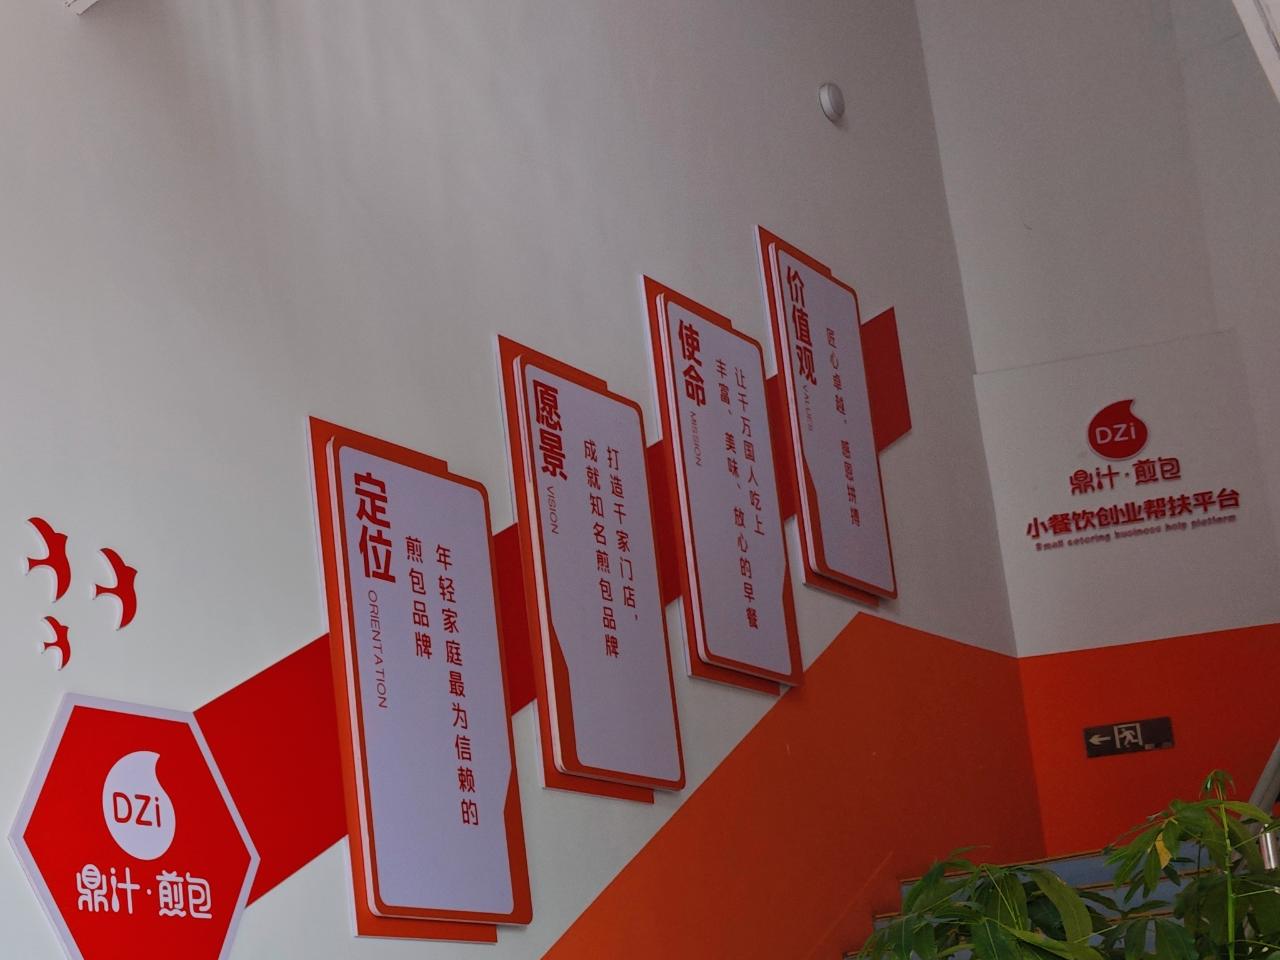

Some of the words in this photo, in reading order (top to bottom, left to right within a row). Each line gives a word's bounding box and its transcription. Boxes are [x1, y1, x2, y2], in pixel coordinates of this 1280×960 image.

[678, 319, 706, 407] 使命
[786, 265, 817, 386] 价值观
[533, 379, 568, 481] 愿景
[734, 367, 765, 536] 让千万国人吃上
[354, 472, 396, 584] 定位
[547, 486, 559, 534] VISION
[583, 438, 619, 658] 成就知名煎包品牌
[1026, 488, 1241, 539] 小餐饮创业帮扶平台
[367, 589, 388, 709] ORIENTATION
[404, 535, 433, 661] 煎包品牌
[435, 543, 479, 827] 年轻家庭最为信赖的
[112, 791, 161, 828] DZi
